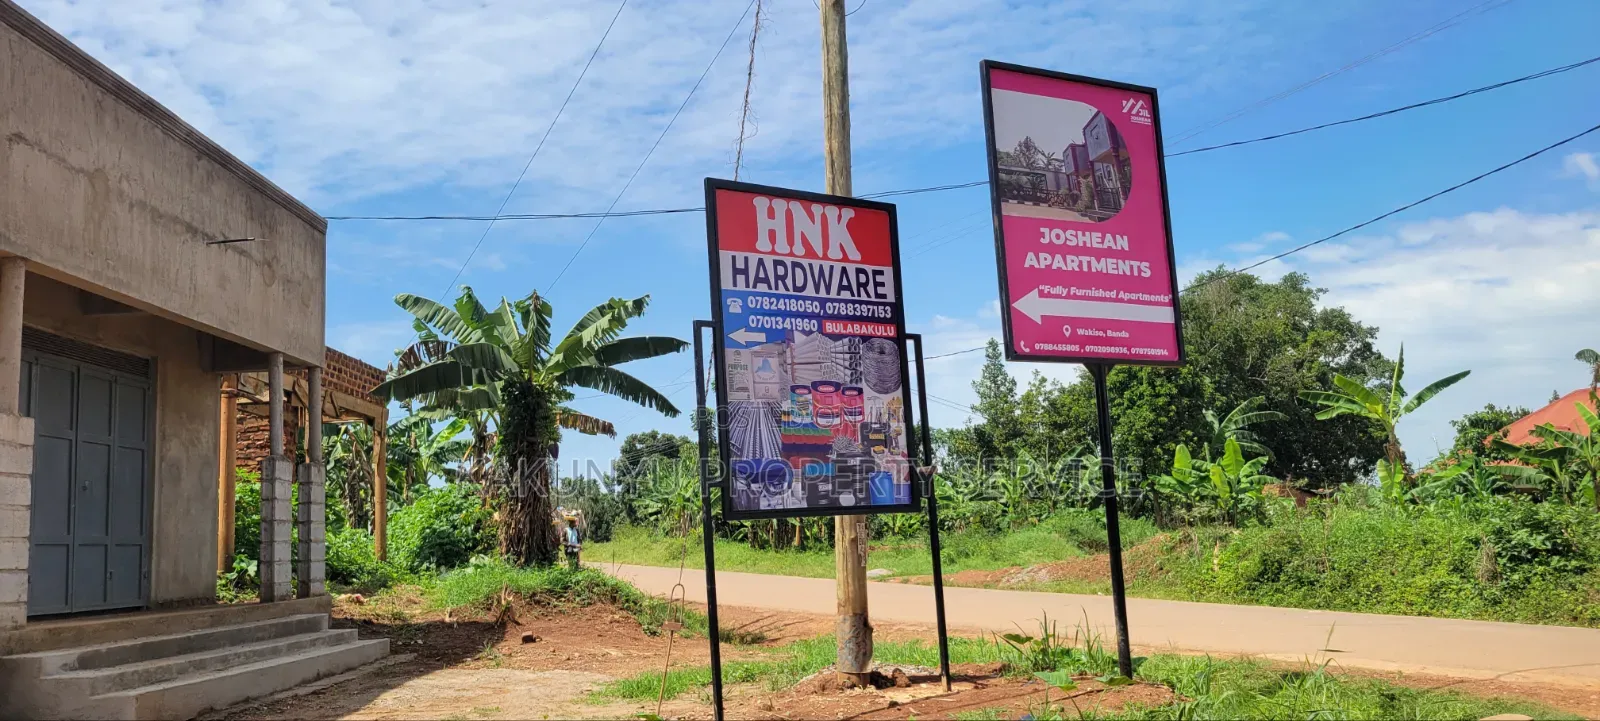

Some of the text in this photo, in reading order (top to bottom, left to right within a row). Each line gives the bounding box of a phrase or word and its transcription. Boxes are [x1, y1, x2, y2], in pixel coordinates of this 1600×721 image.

[753, 196, 861, 261] HNK
[1040, 227, 1129, 251] JOSHEAN
[1024, 252, 1151, 278] APARTMENTS
[731, 255, 888, 299] HARDWARE
[1070, 287, 1117, 298] Furnished
[747, 296, 892, 318] 0782418050, 0788397153
[748, 316, 895, 336] 0701341960 BULABAKULU
[1077, 328, 1129, 338] Wakiso, Banda
